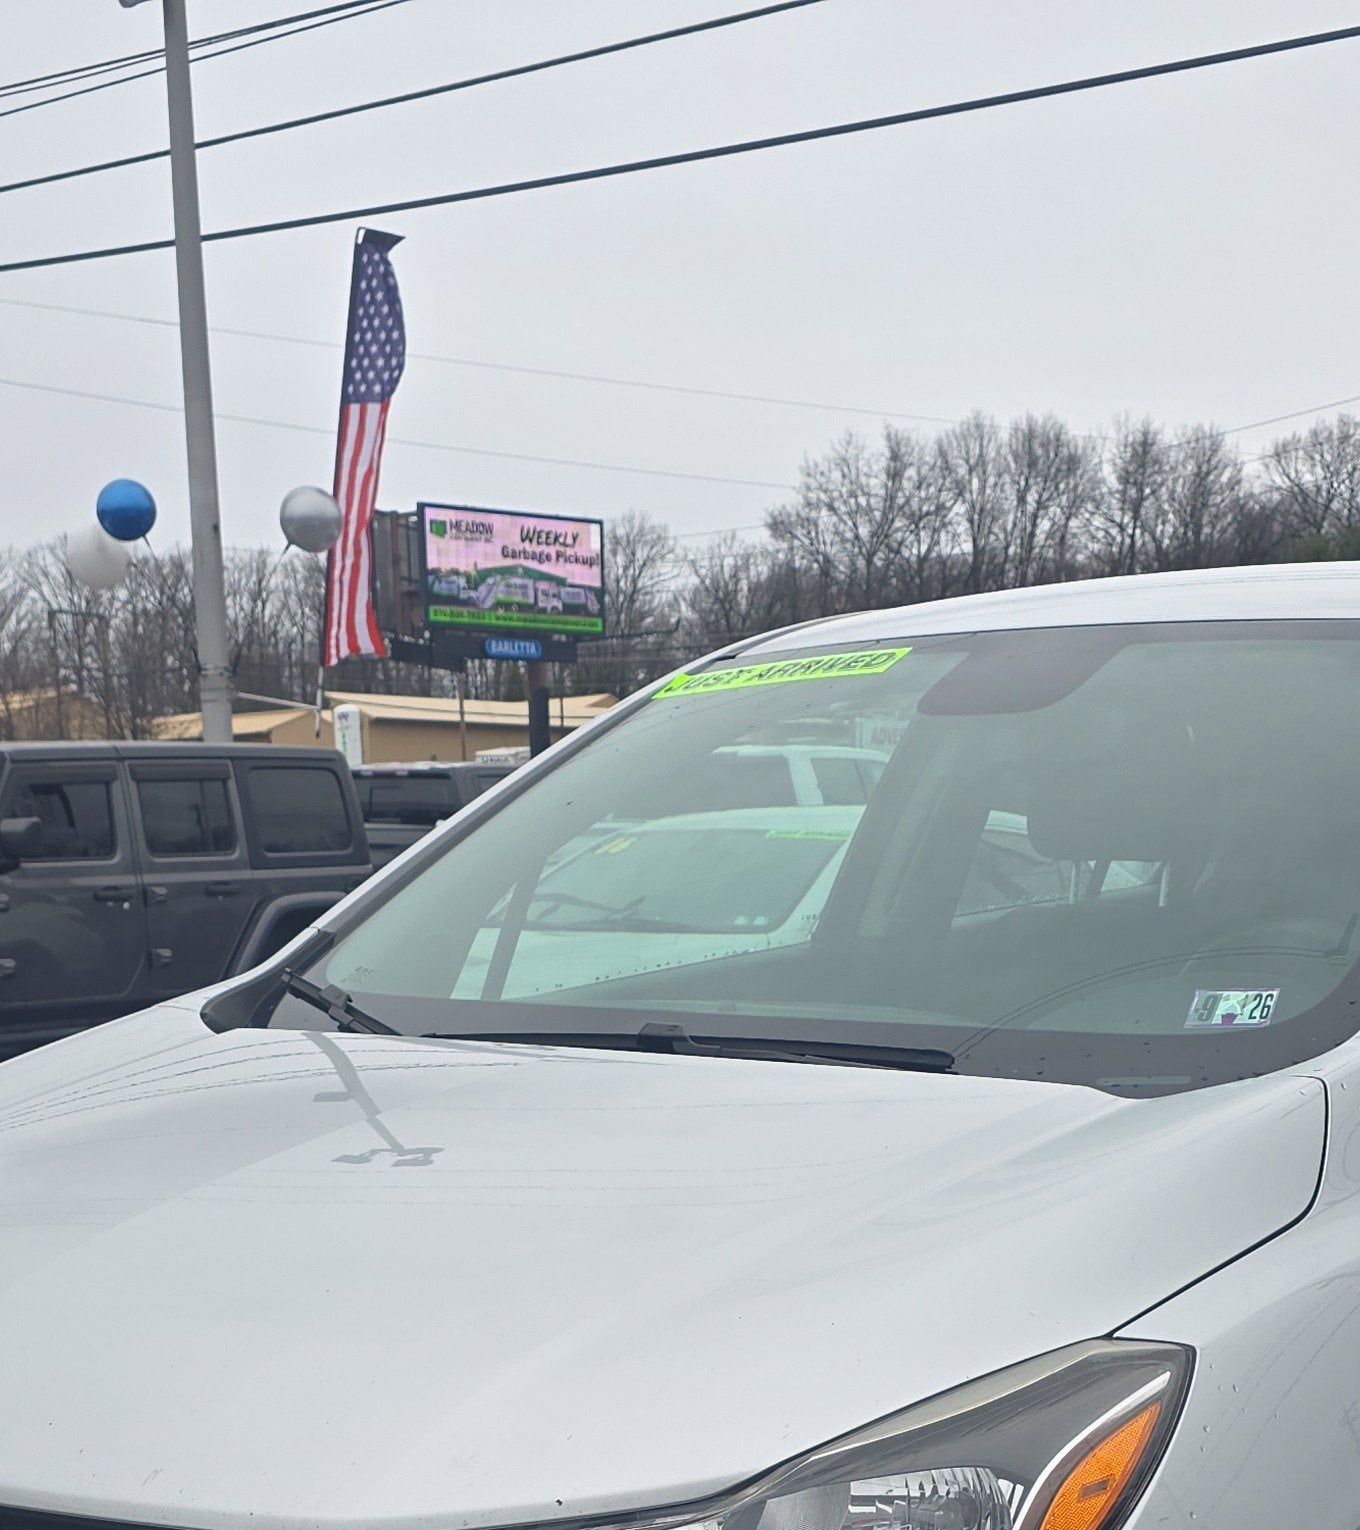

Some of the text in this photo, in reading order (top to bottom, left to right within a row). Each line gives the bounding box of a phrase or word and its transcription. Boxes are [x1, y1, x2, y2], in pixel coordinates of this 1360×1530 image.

[449, 518, 493, 536] MEADOW
[520, 524, 578, 548] WEEKLY
[501, 545, 550, 564] Garbage
[664, 651, 897, 694] JUST ARRIVED
[1248, 993, 1275, 1020] 26
